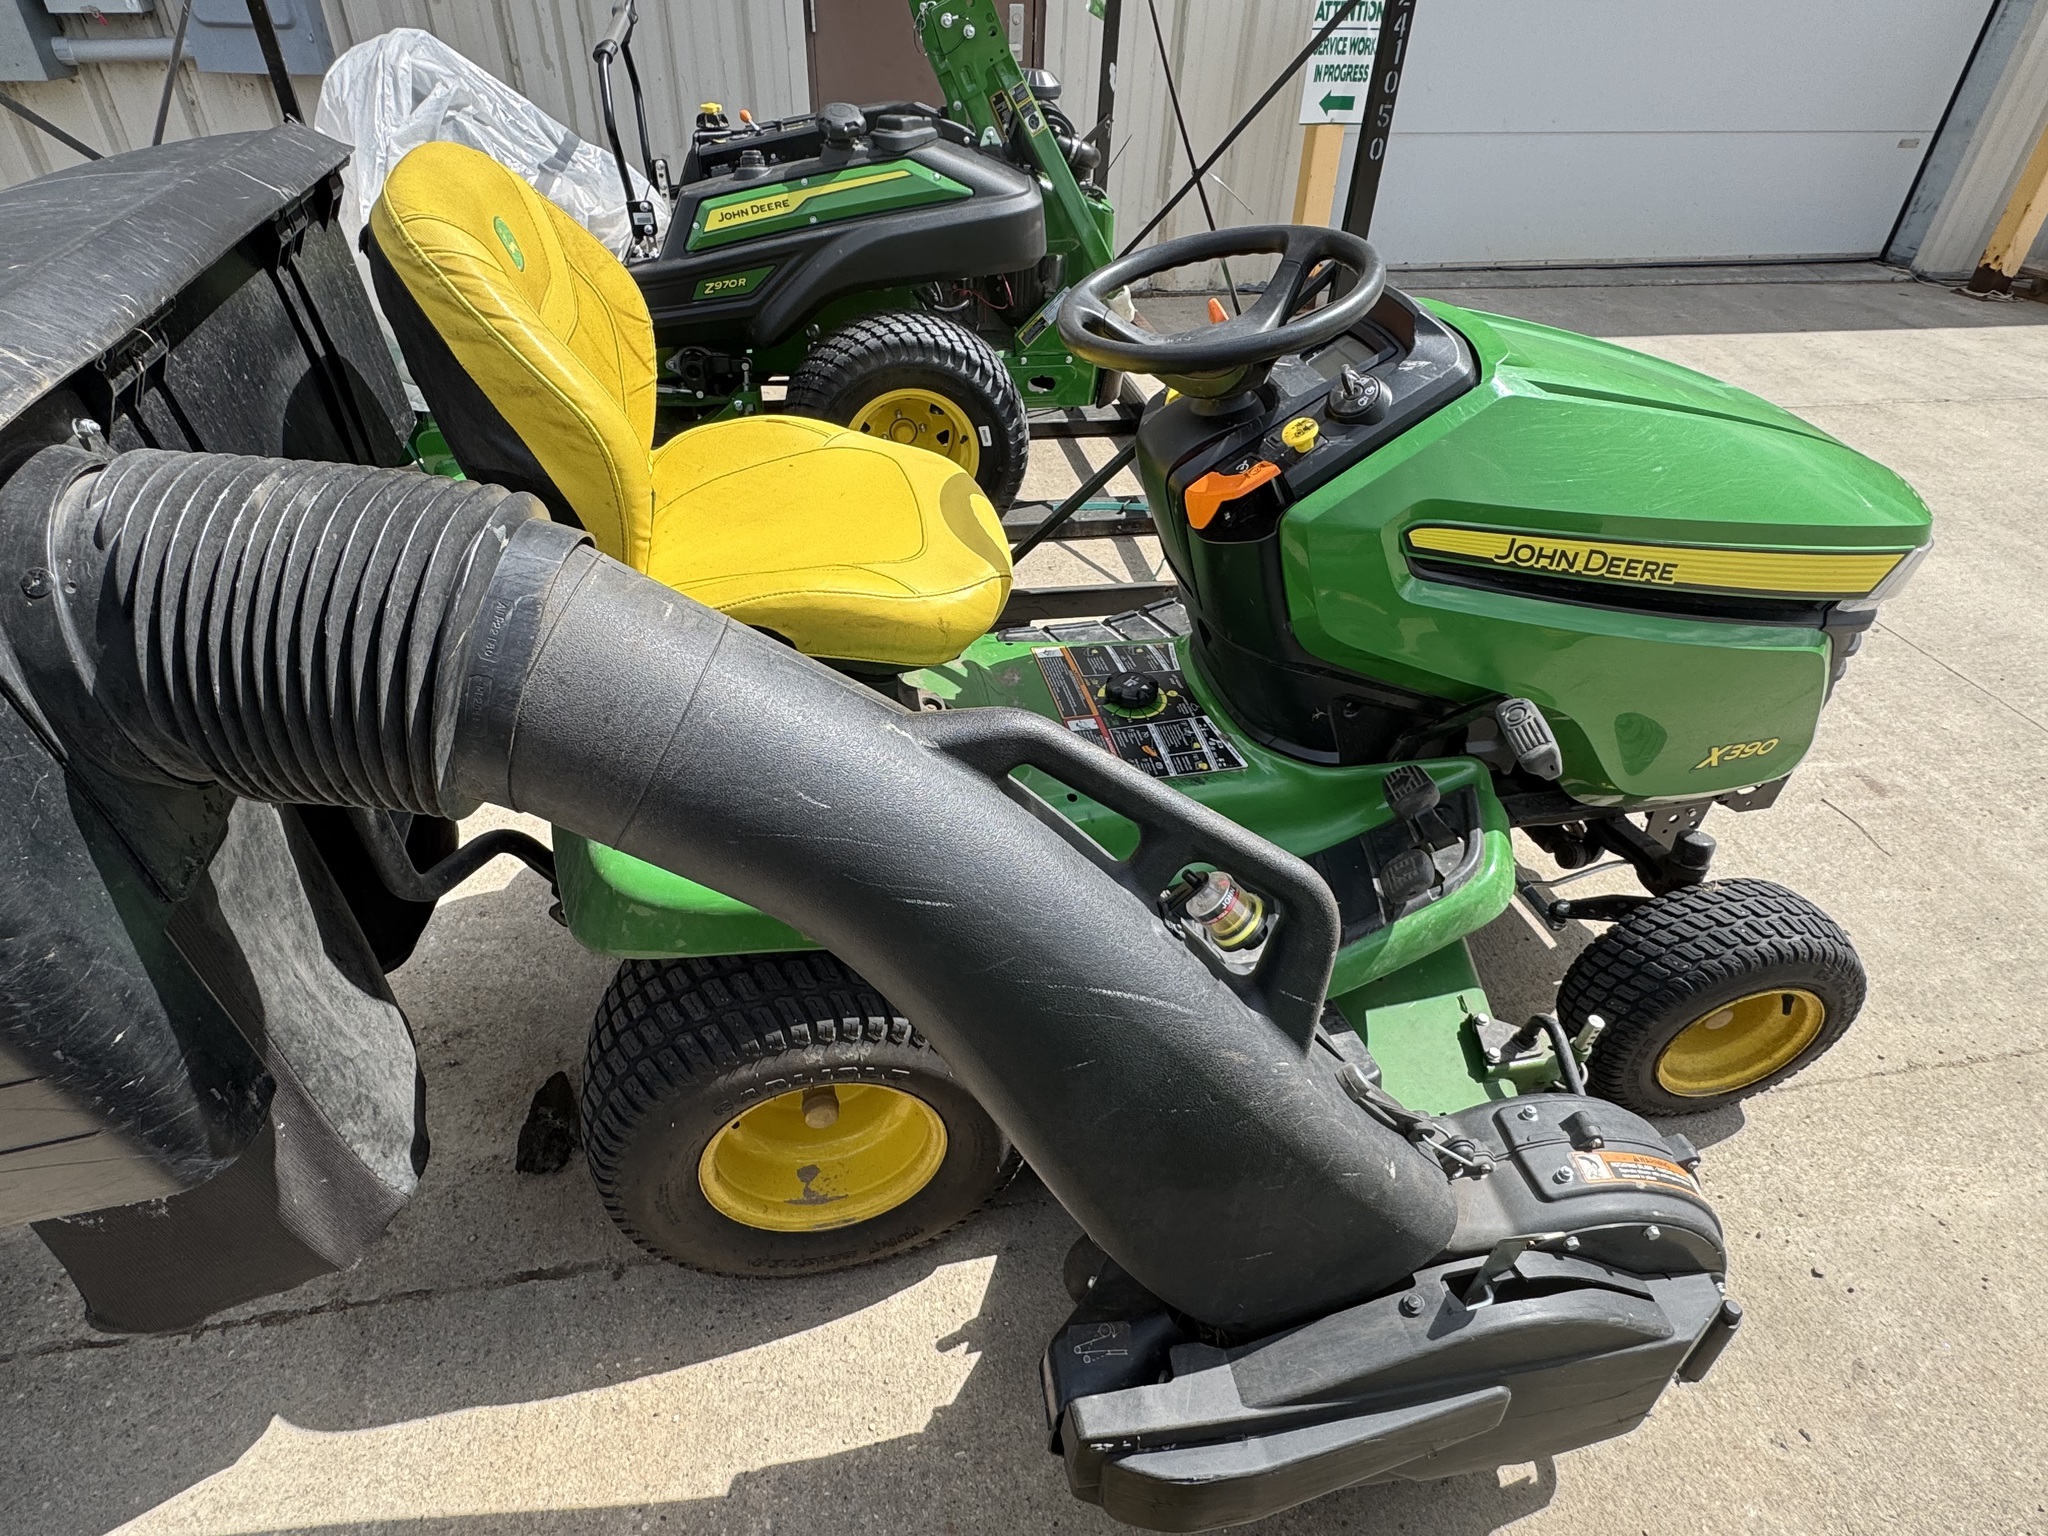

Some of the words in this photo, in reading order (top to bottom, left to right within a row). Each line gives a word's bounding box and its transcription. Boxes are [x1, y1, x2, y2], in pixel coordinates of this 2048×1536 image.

[1348, 36, 1377, 56] WORK
[1313, 64, 1324, 83] IN
[1321, 63, 1370, 83] PROGRESS
[1369, 0, 1411, 160] 41050
[718, 209, 750, 223] JOHN
[750, 199, 791, 215] DEERE
[1493, 537, 1580, 570] JOHN
[1581, 548, 1679, 582] DEERE
[1694, 738, 1779, 770] X390
